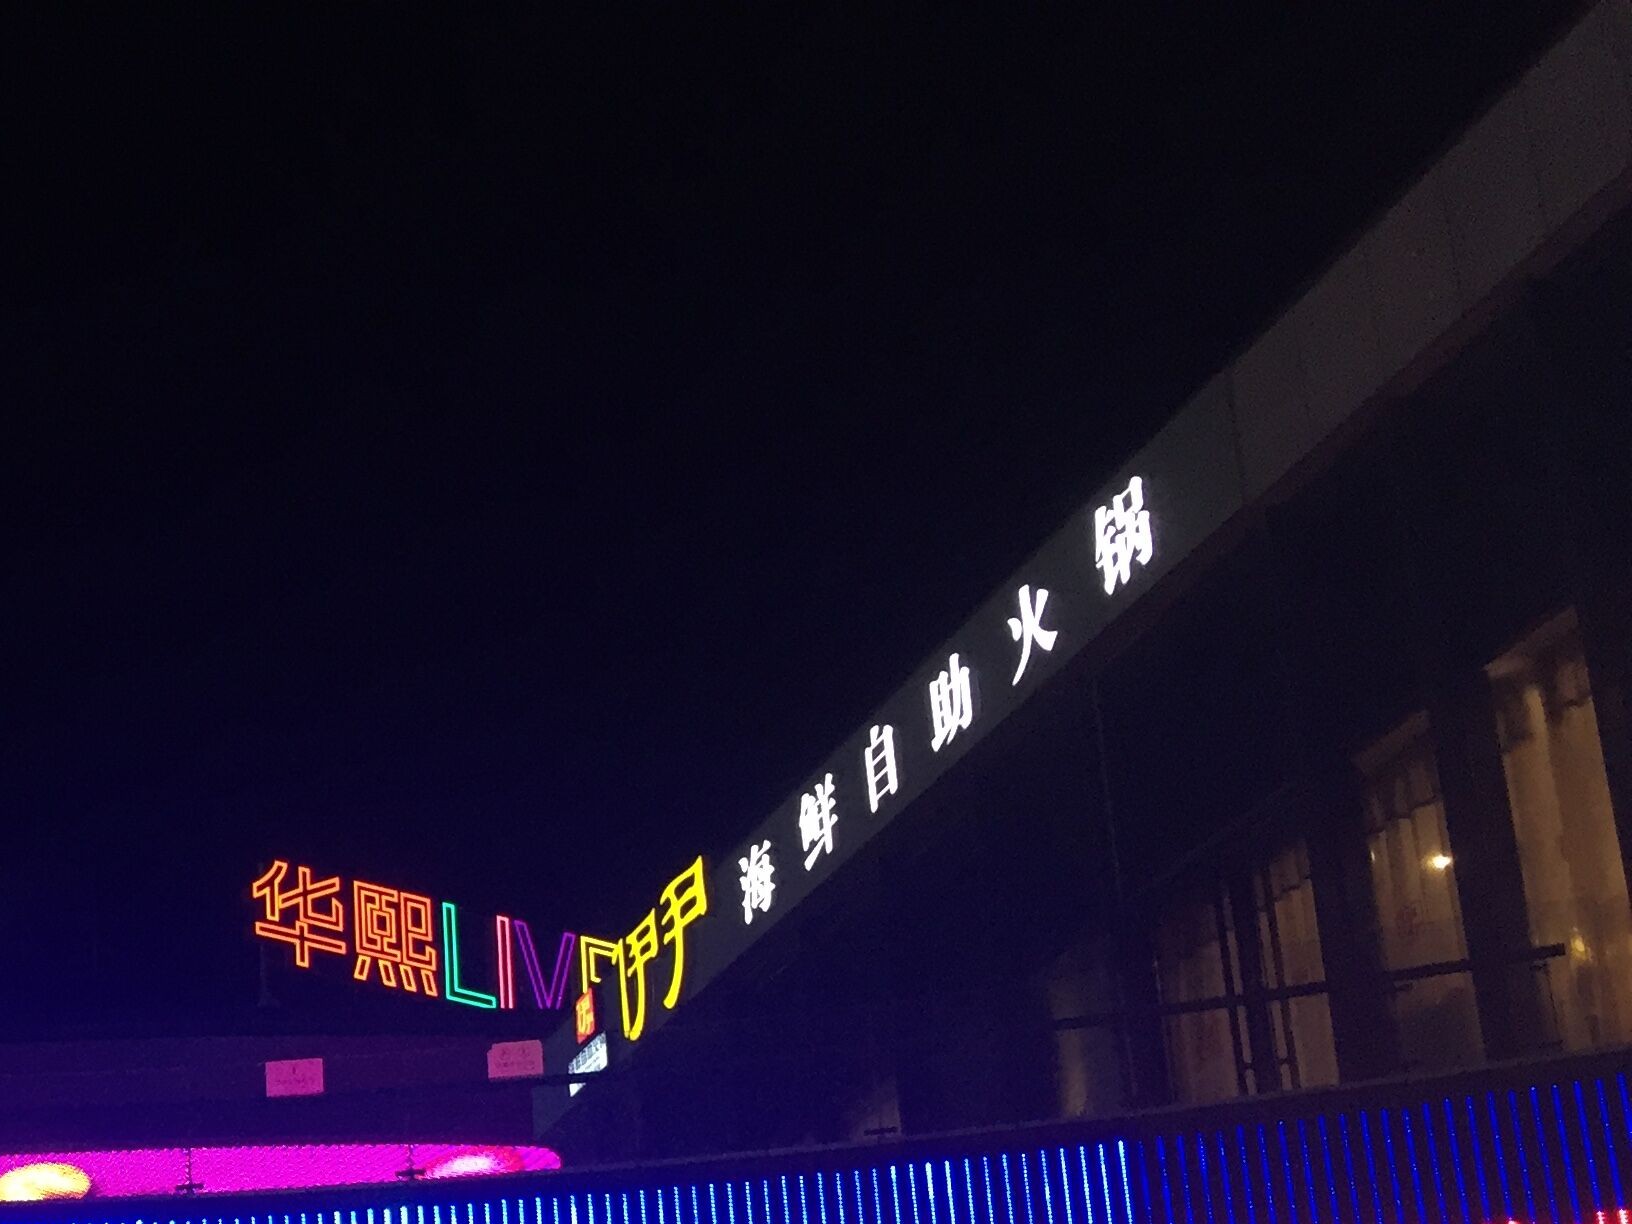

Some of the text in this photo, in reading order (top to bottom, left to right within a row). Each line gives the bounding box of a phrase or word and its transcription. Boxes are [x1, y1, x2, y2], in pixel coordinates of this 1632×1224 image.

[738, 475, 1154, 925] 海鲜自助火锅
